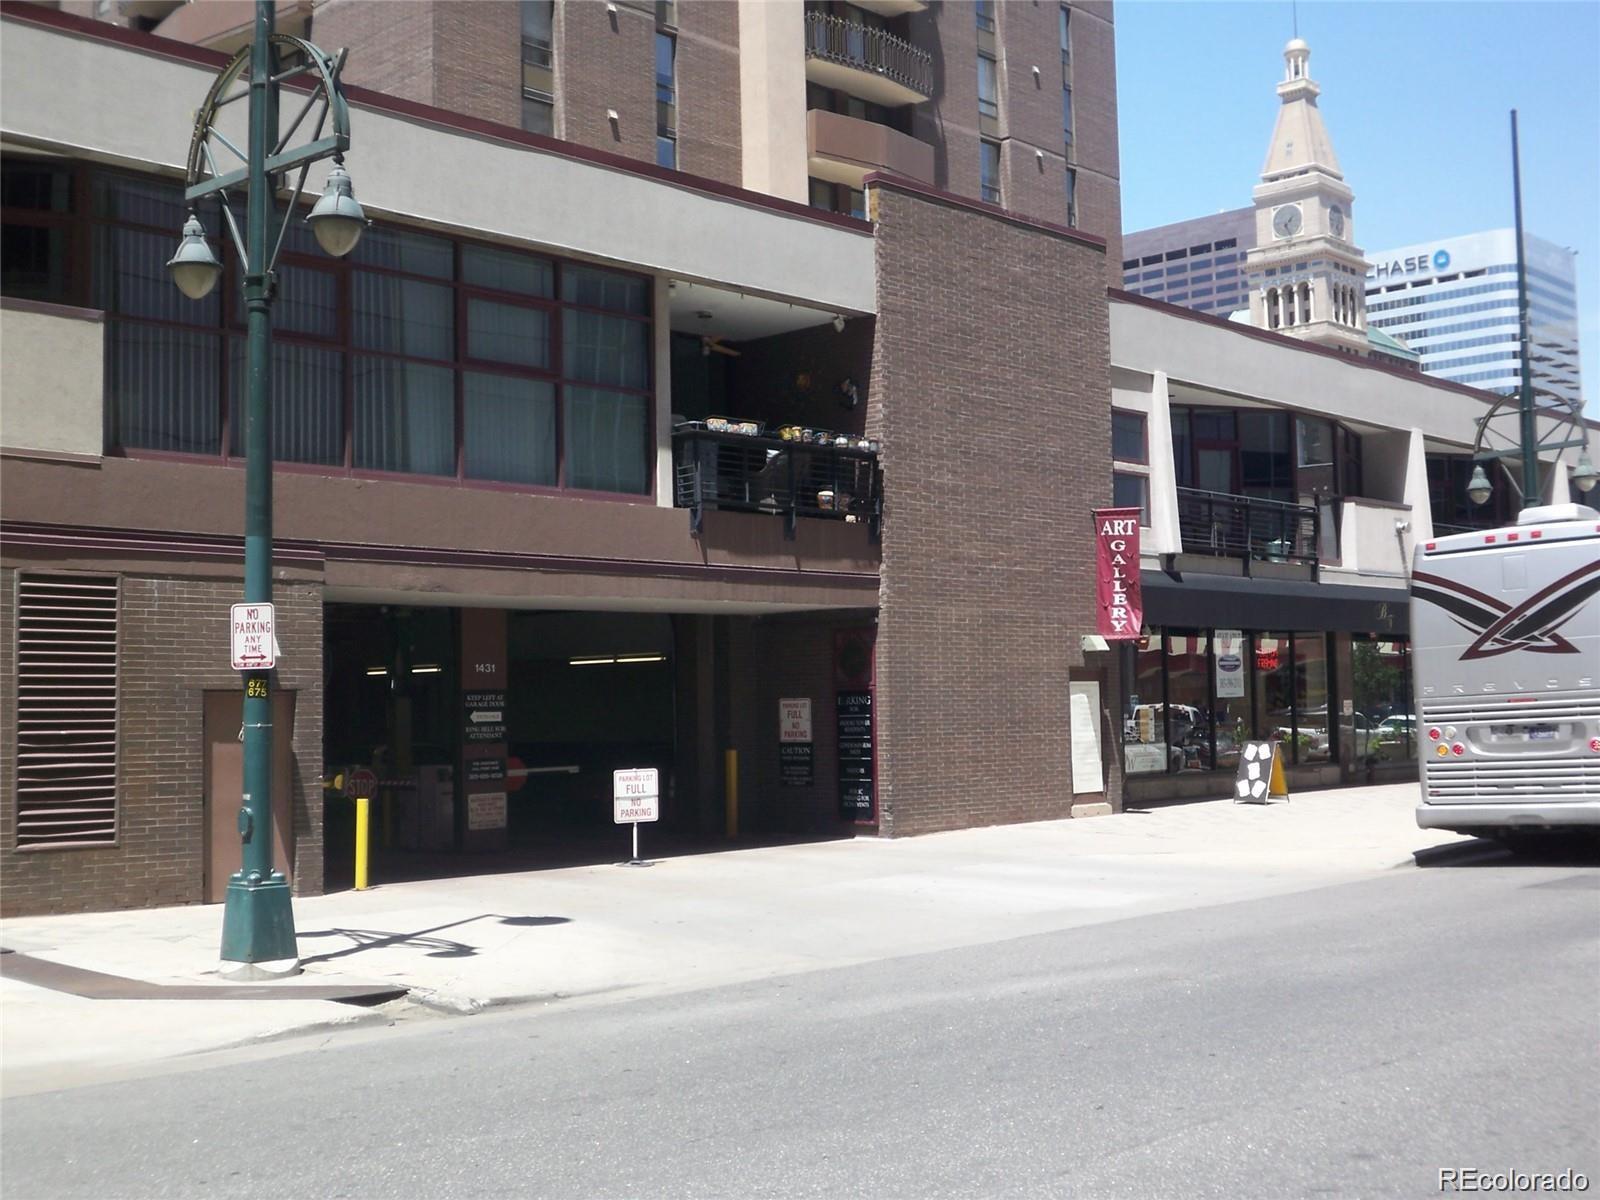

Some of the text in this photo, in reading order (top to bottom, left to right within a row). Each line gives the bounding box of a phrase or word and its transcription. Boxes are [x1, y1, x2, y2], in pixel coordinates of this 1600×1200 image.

[1101, 519, 1136, 536] ART
[1110, 539, 1128, 632] GALLERY
[246, 608, 259, 620] NO
[235, 621, 271, 634] PARKING
[245, 635, 261, 643] ANY
[244, 644, 262, 653] TIME
[475, 663, 496, 673] 1431
[248, 688, 267, 697] 675
[787, 710, 803, 719] FULL
[791, 721, 800, 730] NO
[784, 730, 808, 738] PARKING
[626, 784, 647, 794] FULL
[631, 798, 642, 807] NO
[620, 807, 652, 818] PARKING
